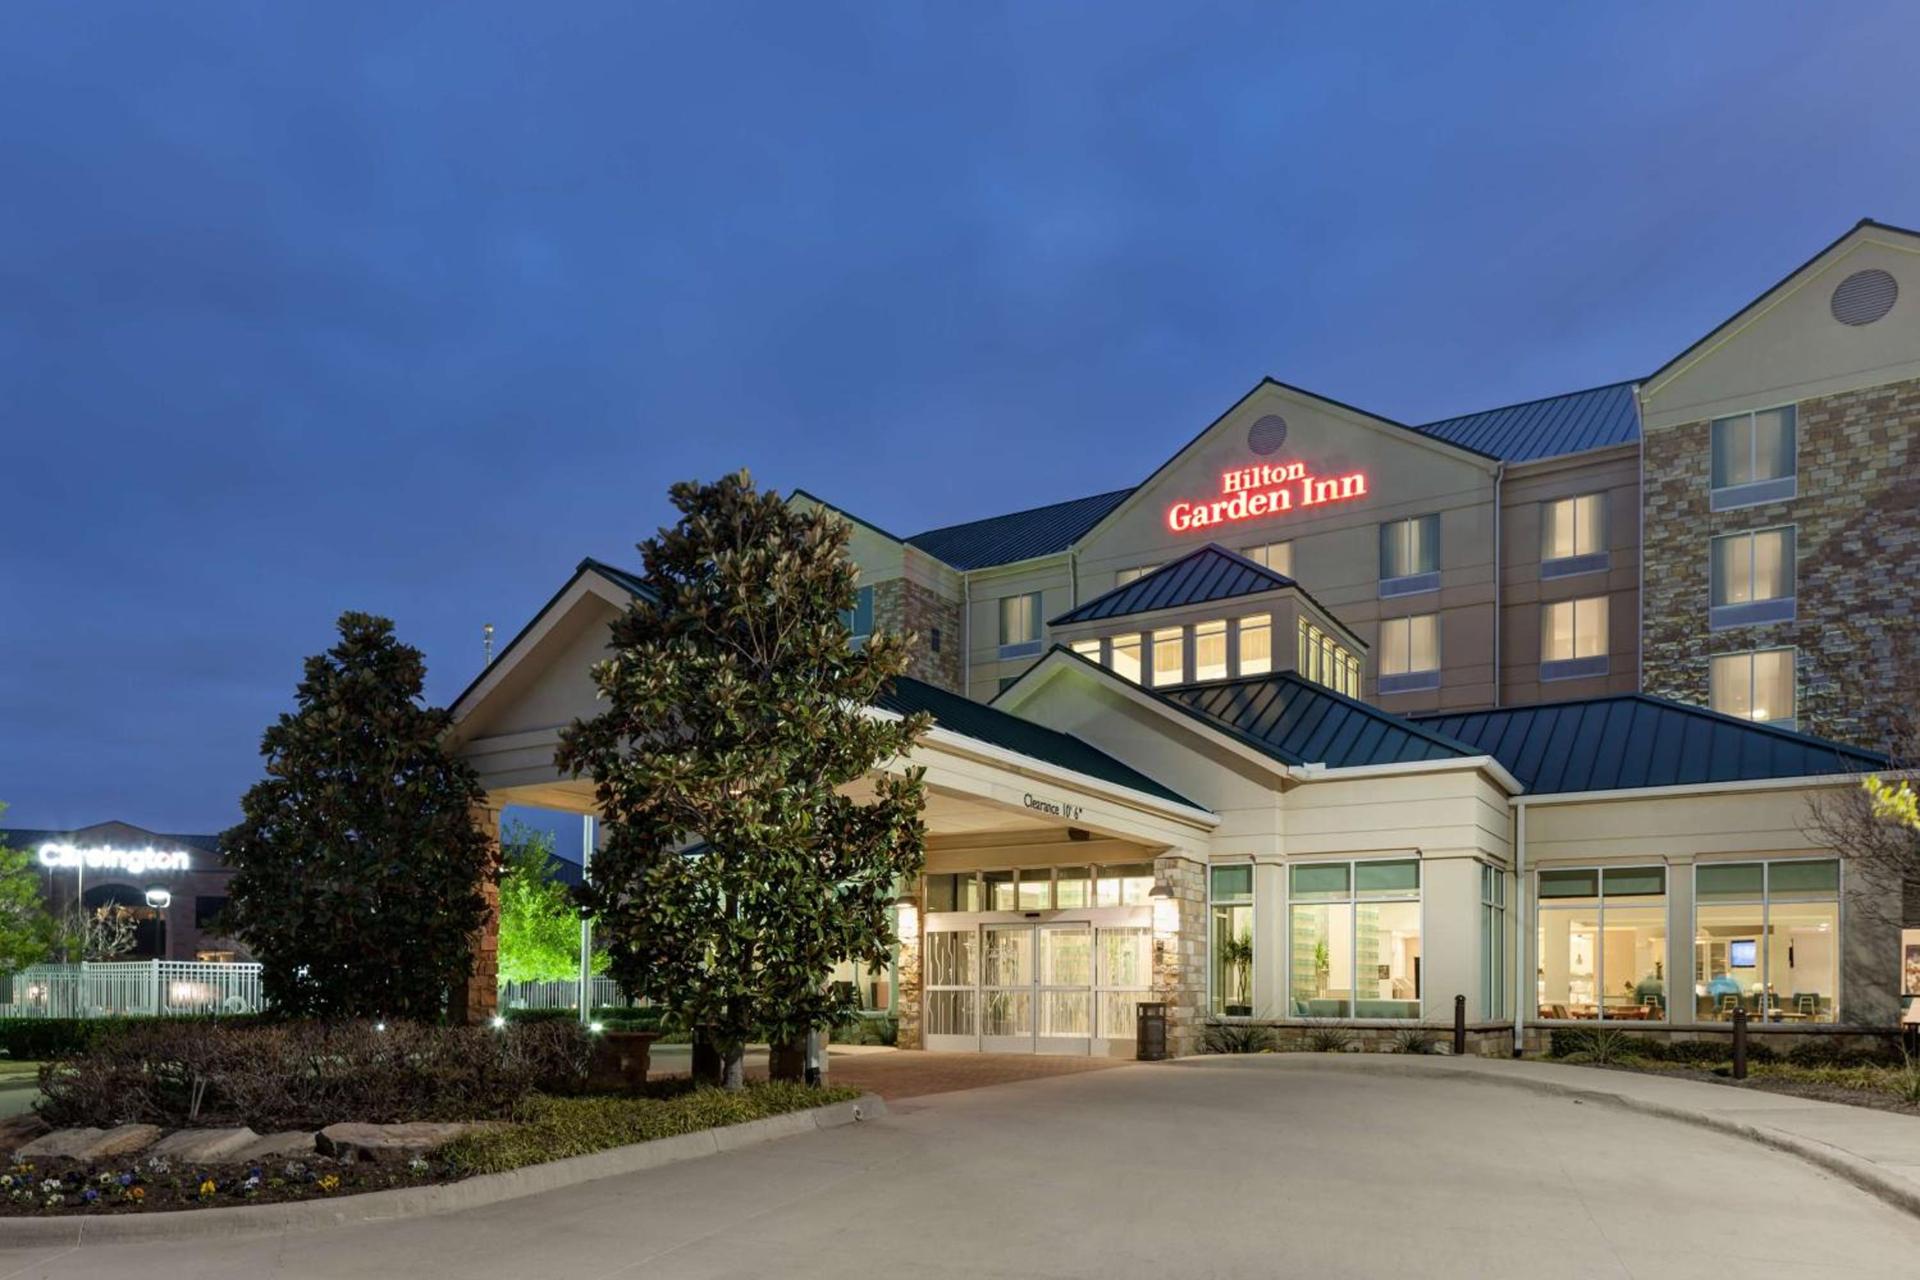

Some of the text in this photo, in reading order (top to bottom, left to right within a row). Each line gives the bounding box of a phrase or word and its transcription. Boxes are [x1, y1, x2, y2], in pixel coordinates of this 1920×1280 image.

[1222, 461, 1306, 494] Hilton
[1168, 472, 1368, 532] Garden Inn
[1023, 791, 1060, 816] Clearance
